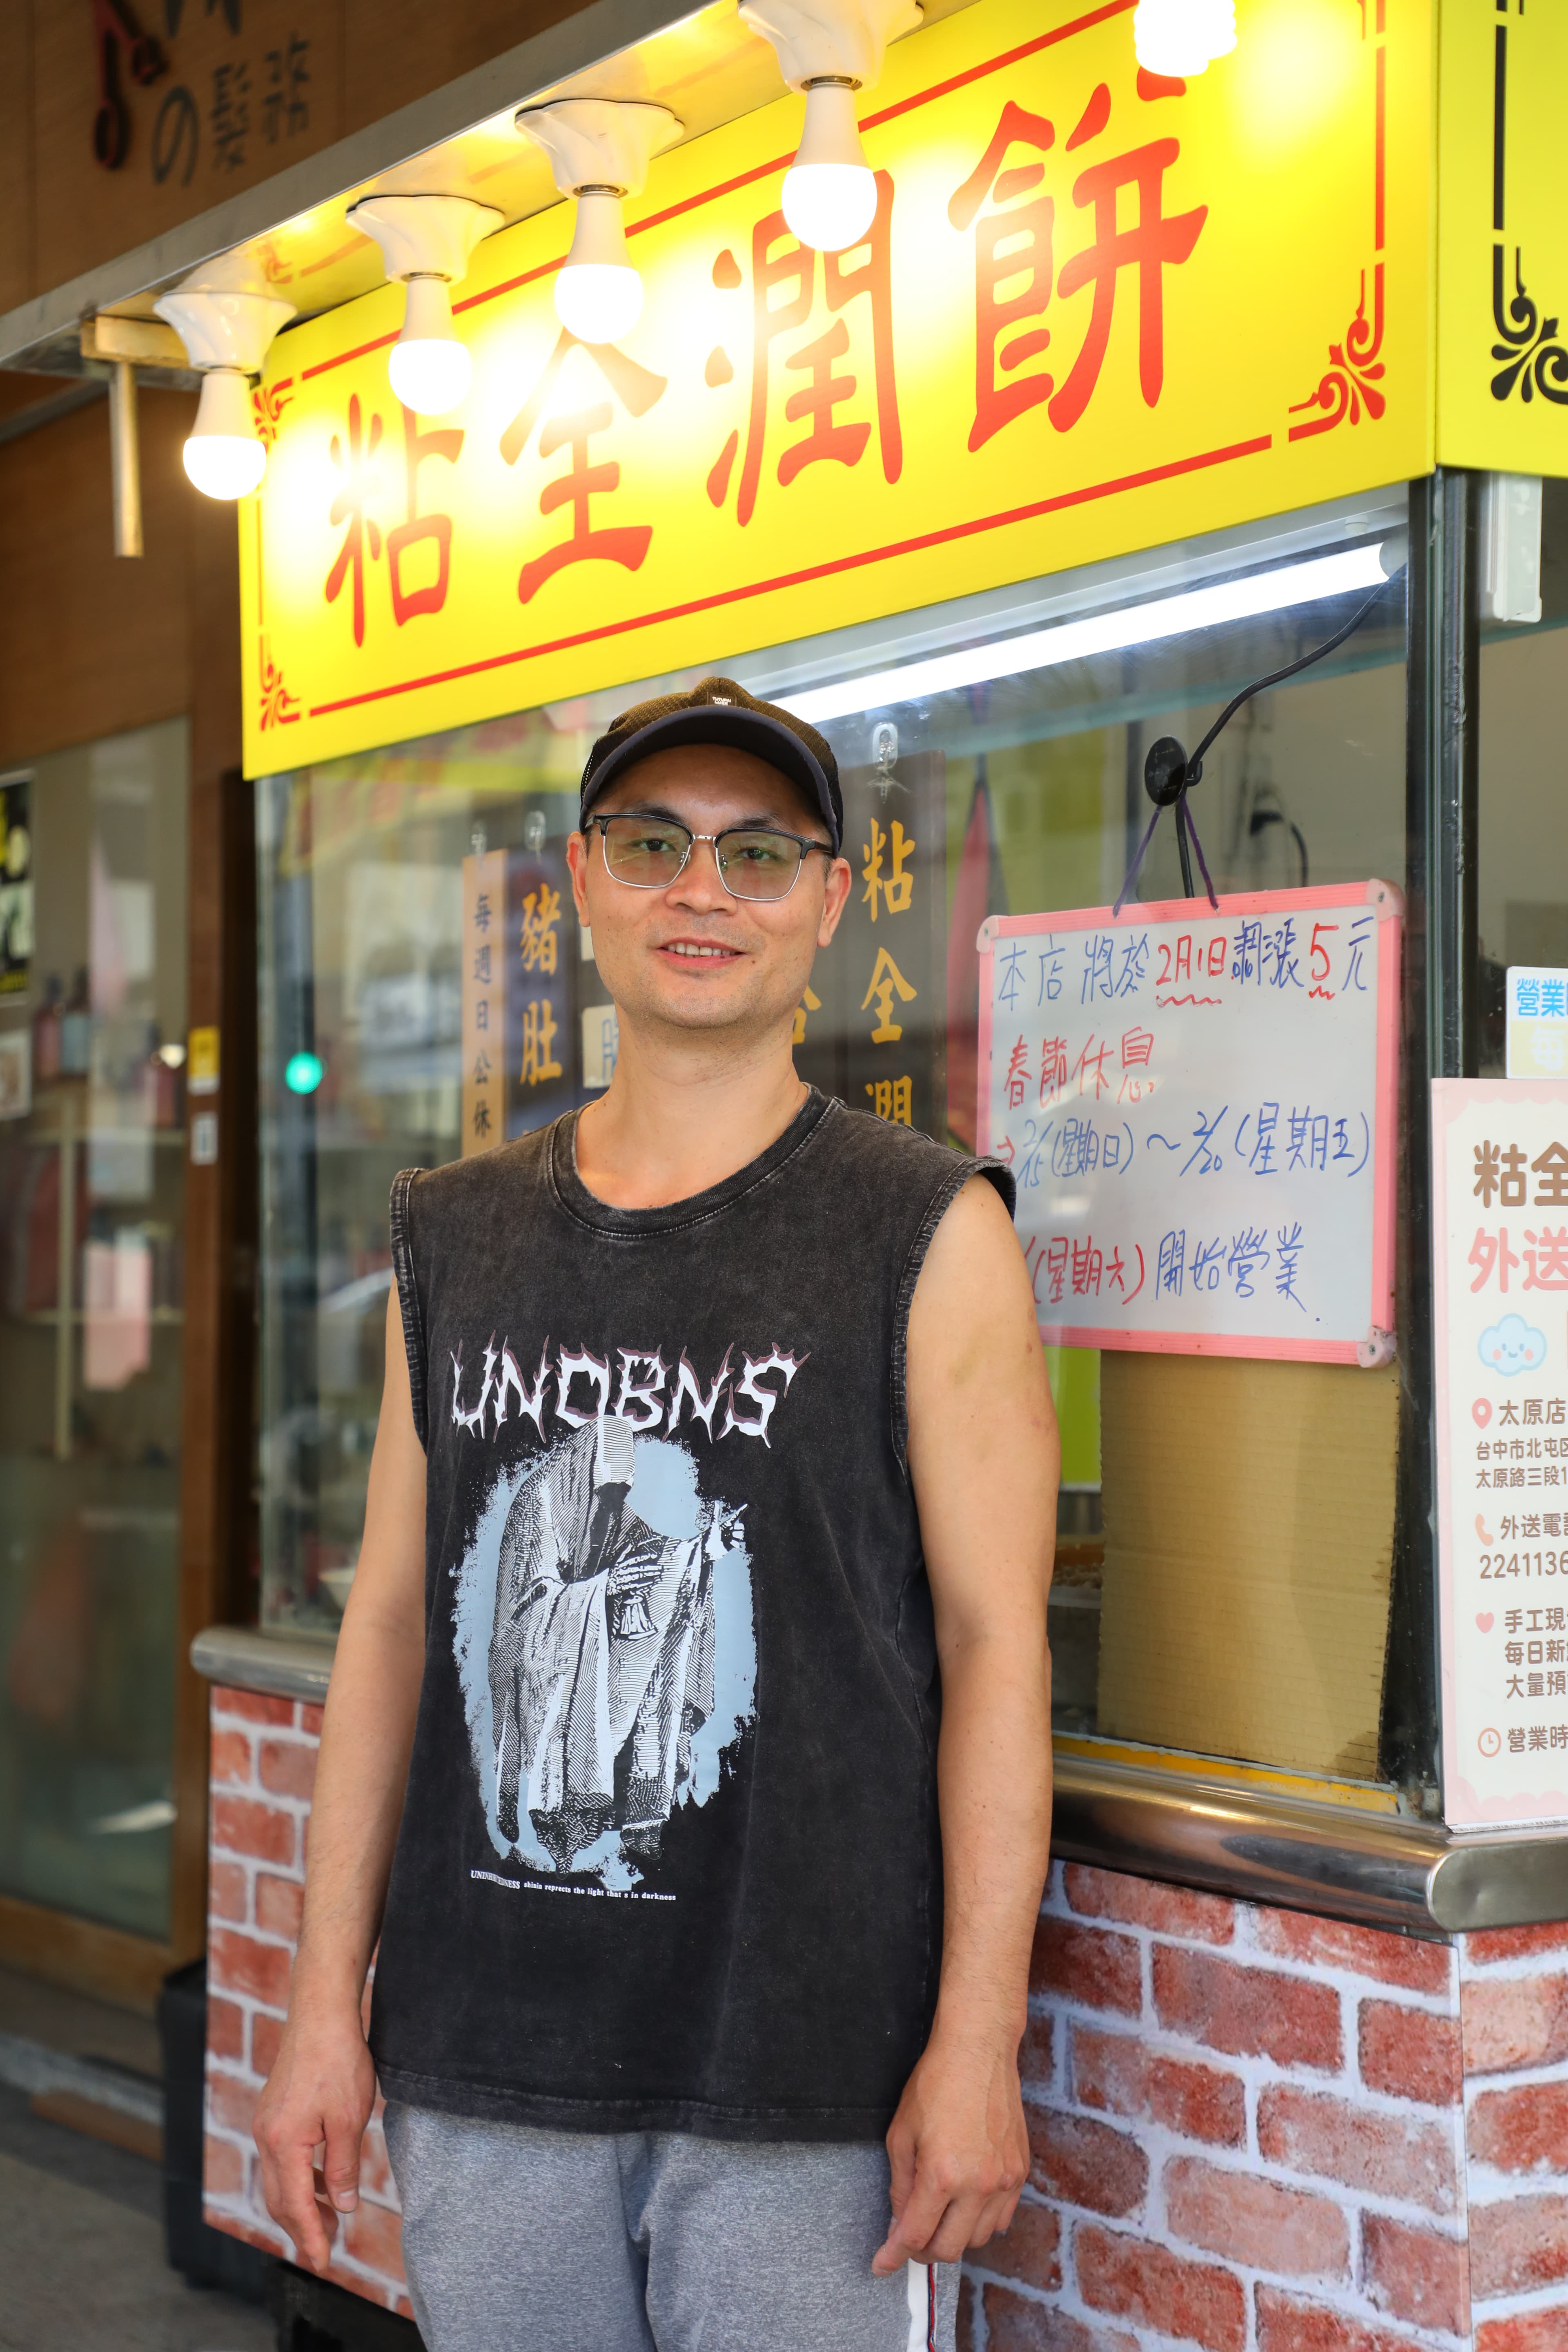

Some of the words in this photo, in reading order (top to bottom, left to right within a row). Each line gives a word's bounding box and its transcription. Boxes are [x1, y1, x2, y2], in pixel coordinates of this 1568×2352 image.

[325, 69, 1209, 647] 粘全潤餅
[520, 882, 563, 1134] 豬肚
[1517, 978, 1568, 1017] 營業
[472, 894, 492, 1138] 每週日公休
[1004, 1026, 1155, 1110] 春節休息
[1468, 1226, 1568, 1293] 外送
[1499, 1398, 1566, 1426] 太原店
[1476, 1466, 1567, 1488] 太原路三段1
[1501, 1512, 1568, 1539] 外送電
[1480, 1550, 1568, 1579] 2241136
[1505, 1607, 1568, 1633] 手工現
[1505, 1639, 1568, 1666] 每日新
[1506, 1671, 1568, 1699] 大量預
[1508, 1724, 1568, 1753] 營業時
[587, 1888, 604, 1897] light
[641, 1892, 676, 1901] darkness
